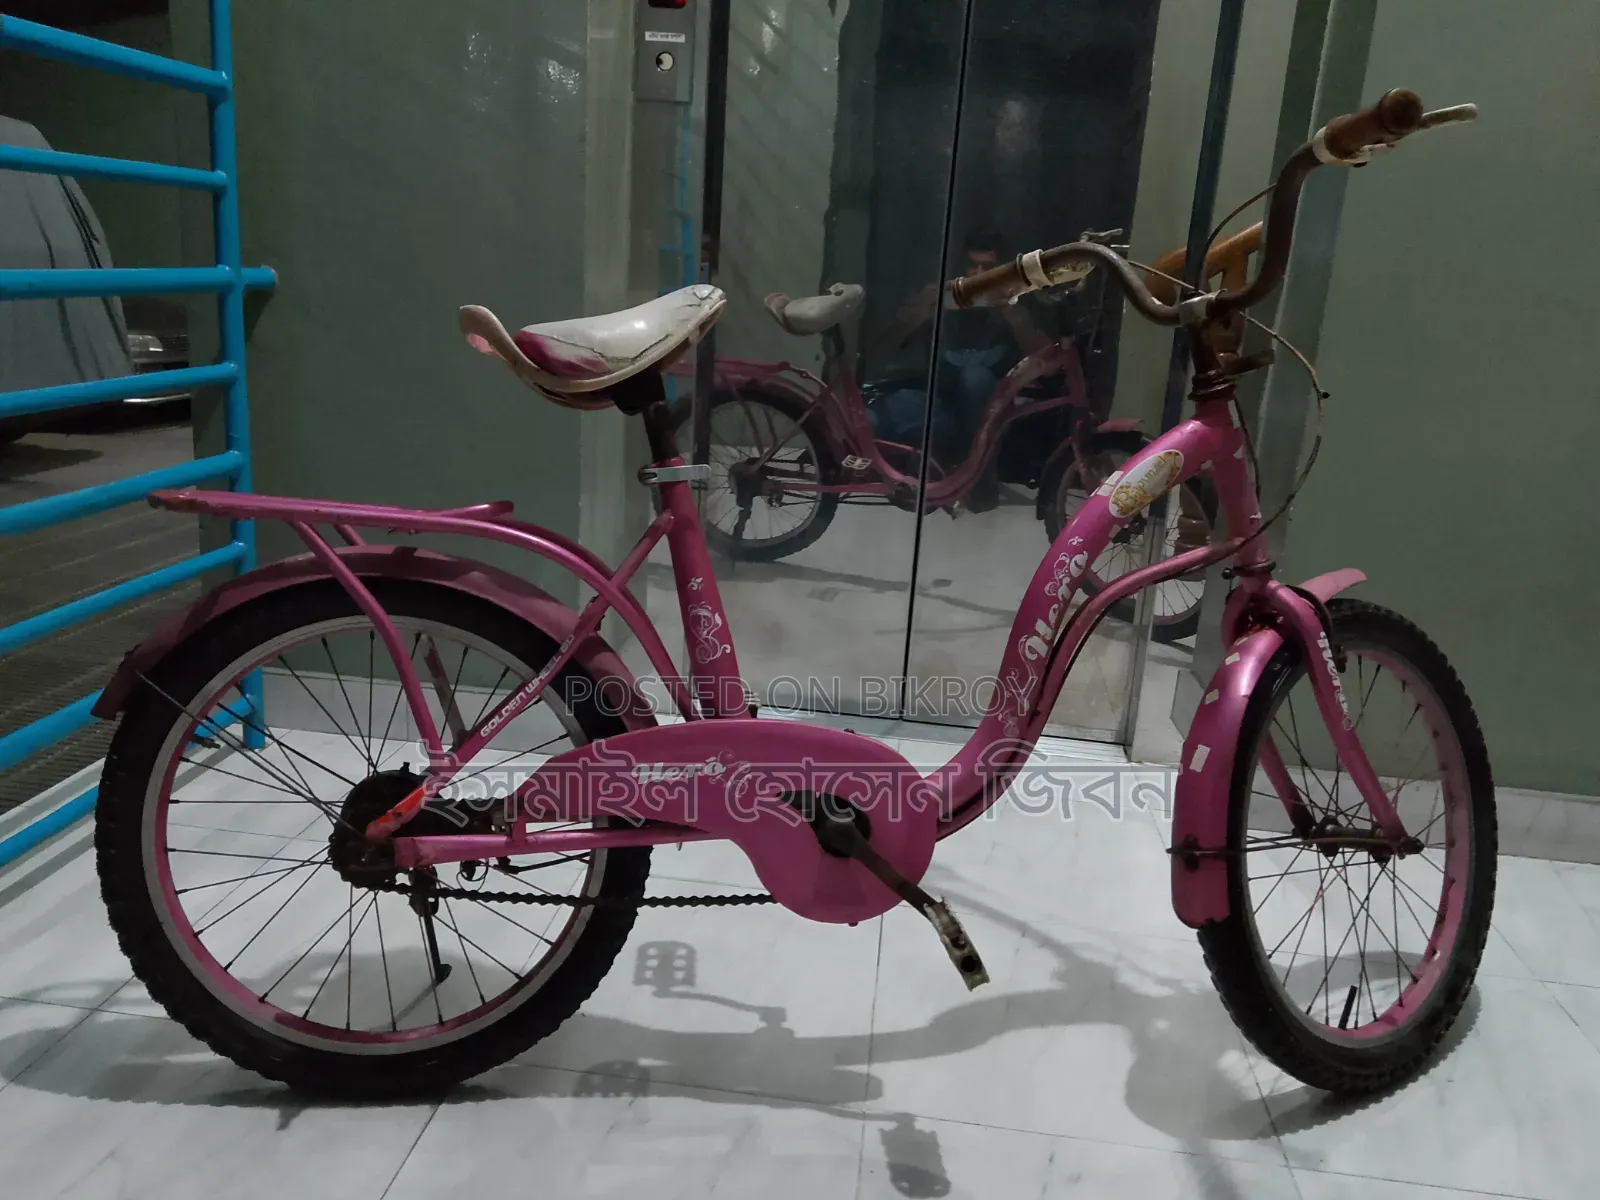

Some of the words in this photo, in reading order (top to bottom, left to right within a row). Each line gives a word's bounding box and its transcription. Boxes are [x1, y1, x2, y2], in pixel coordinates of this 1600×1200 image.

[1025, 551, 1088, 660] Hero
[480, 691, 527, 737] GOLDEN
[525, 655, 562, 694] WHEEL
[631, 756, 726, 784] Hero
